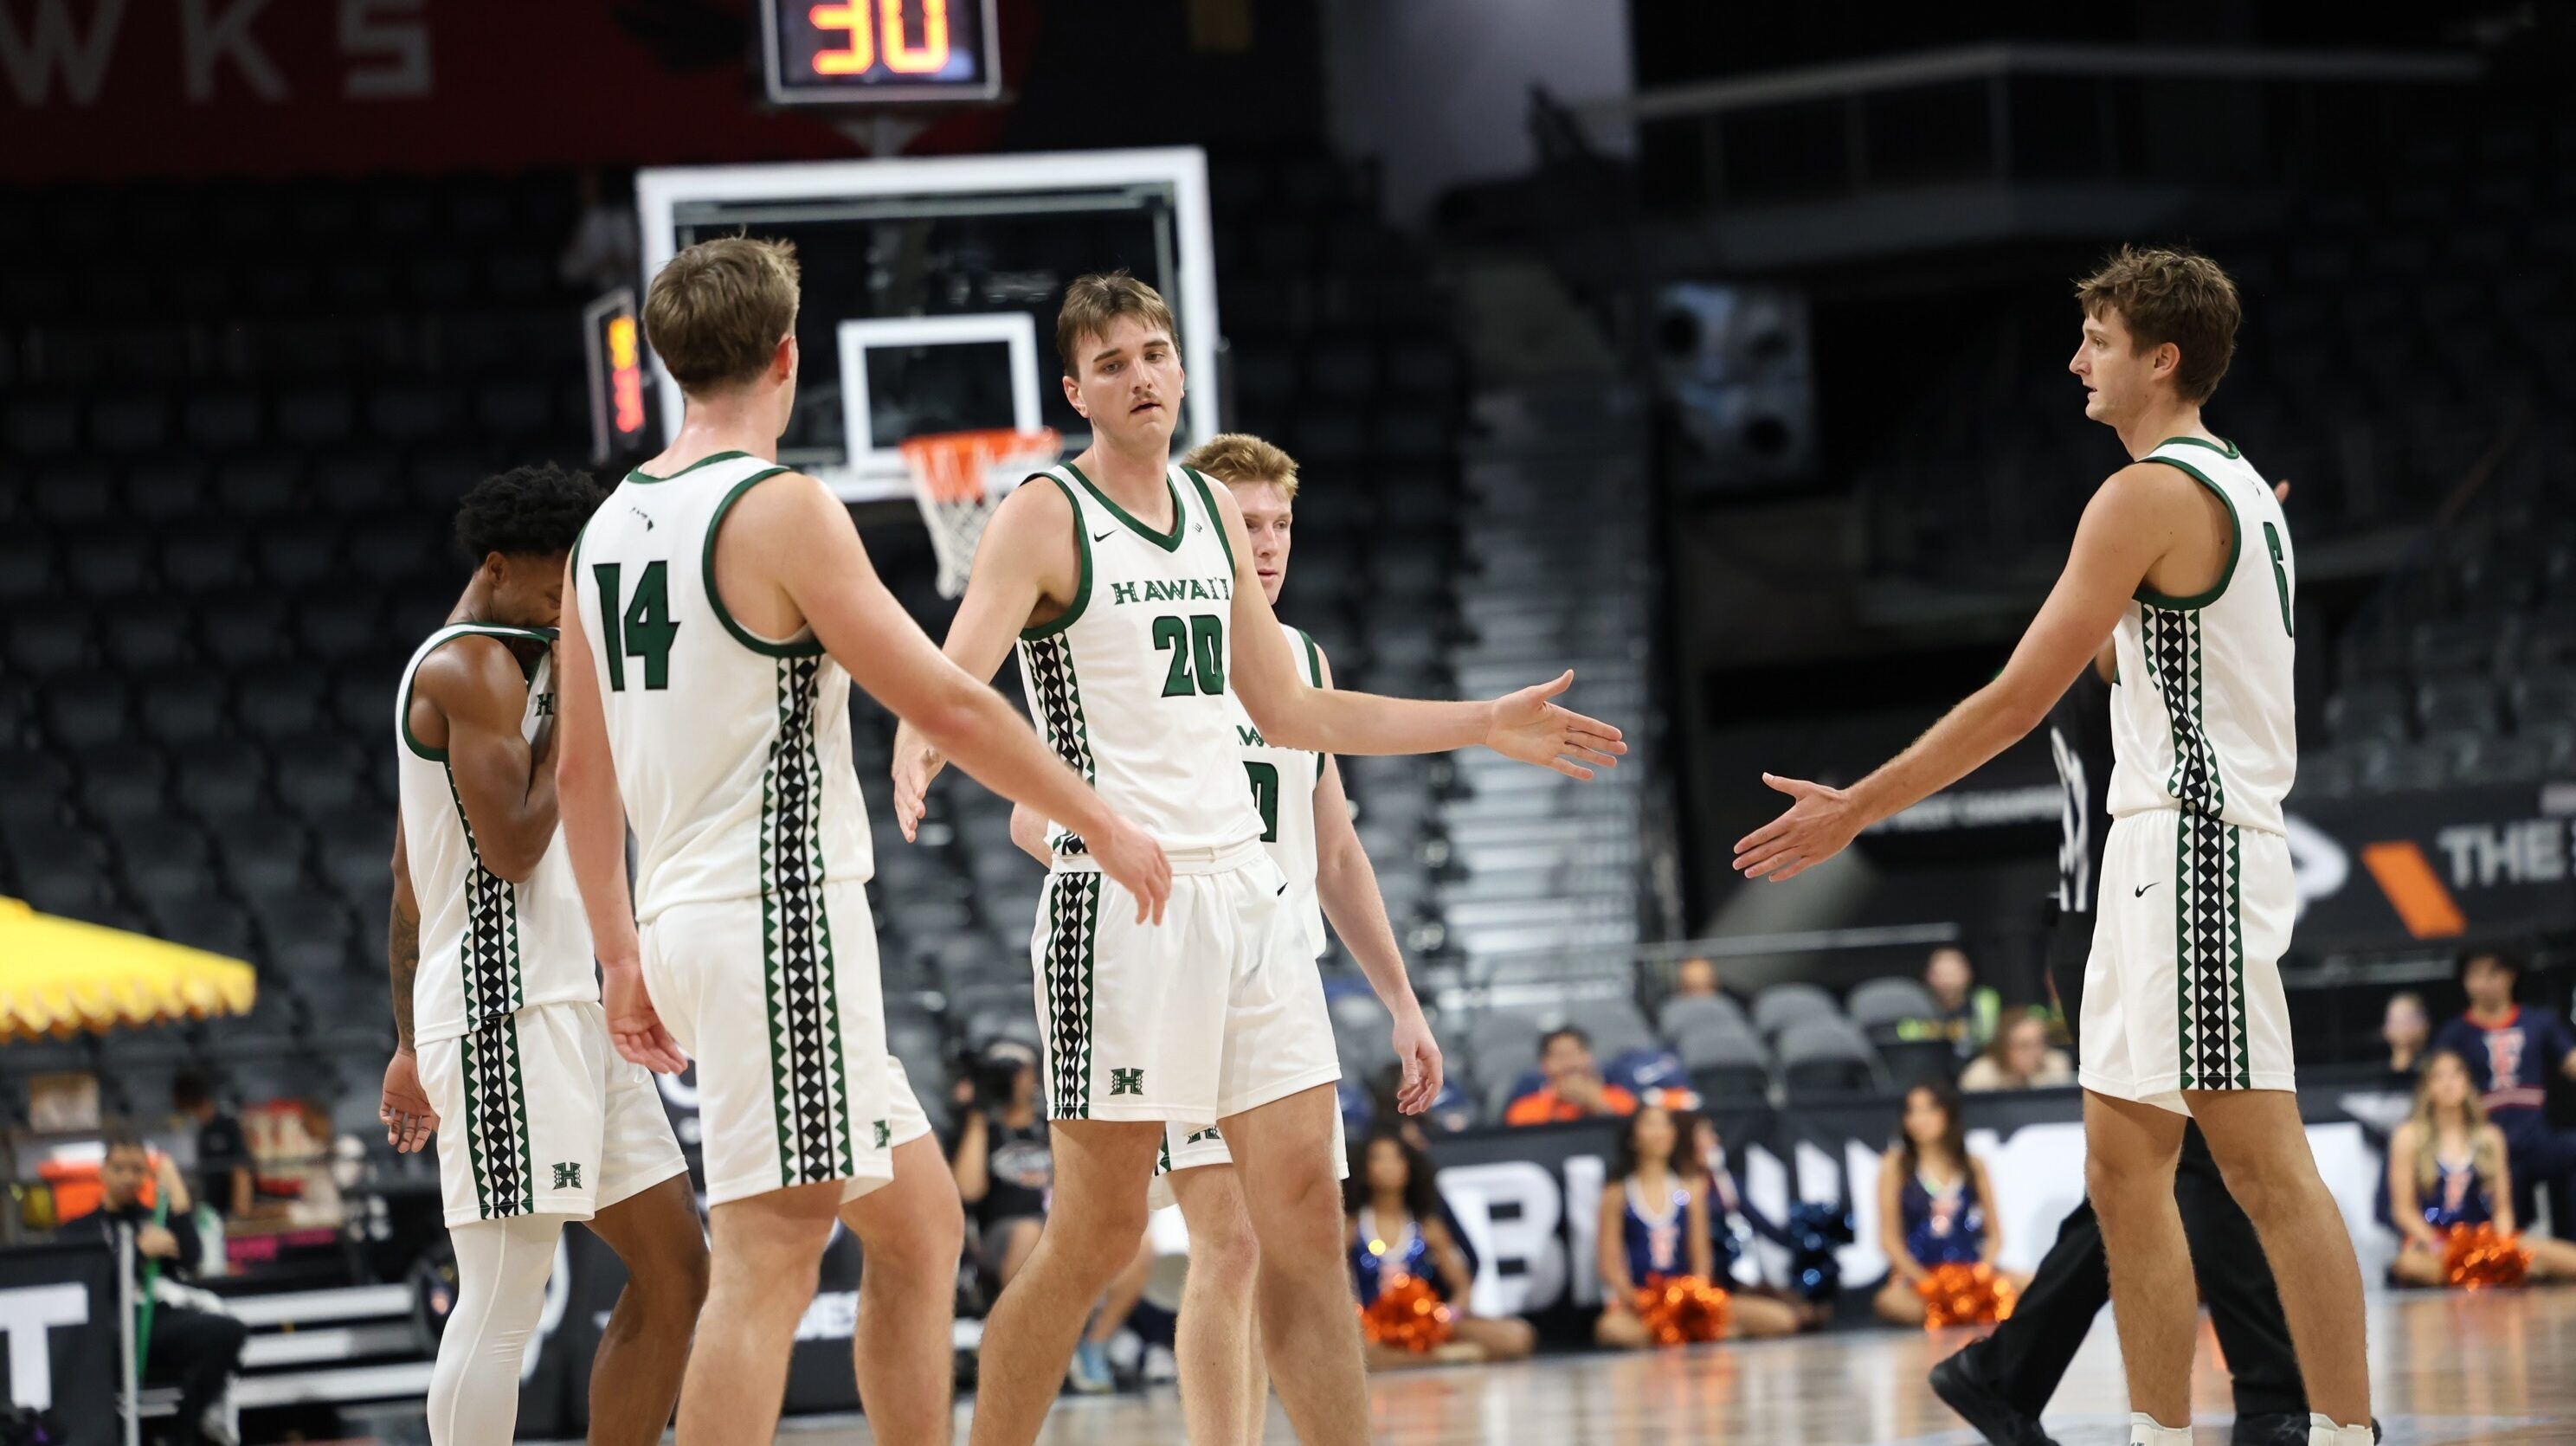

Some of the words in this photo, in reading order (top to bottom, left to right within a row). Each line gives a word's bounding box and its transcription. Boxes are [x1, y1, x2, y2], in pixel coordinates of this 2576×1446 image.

[810, 0, 950, 75] 30
[592, 560, 681, 692] 14
[1152, 614, 1224, 697] 20
[2436, 818, 2567, 889] THE
